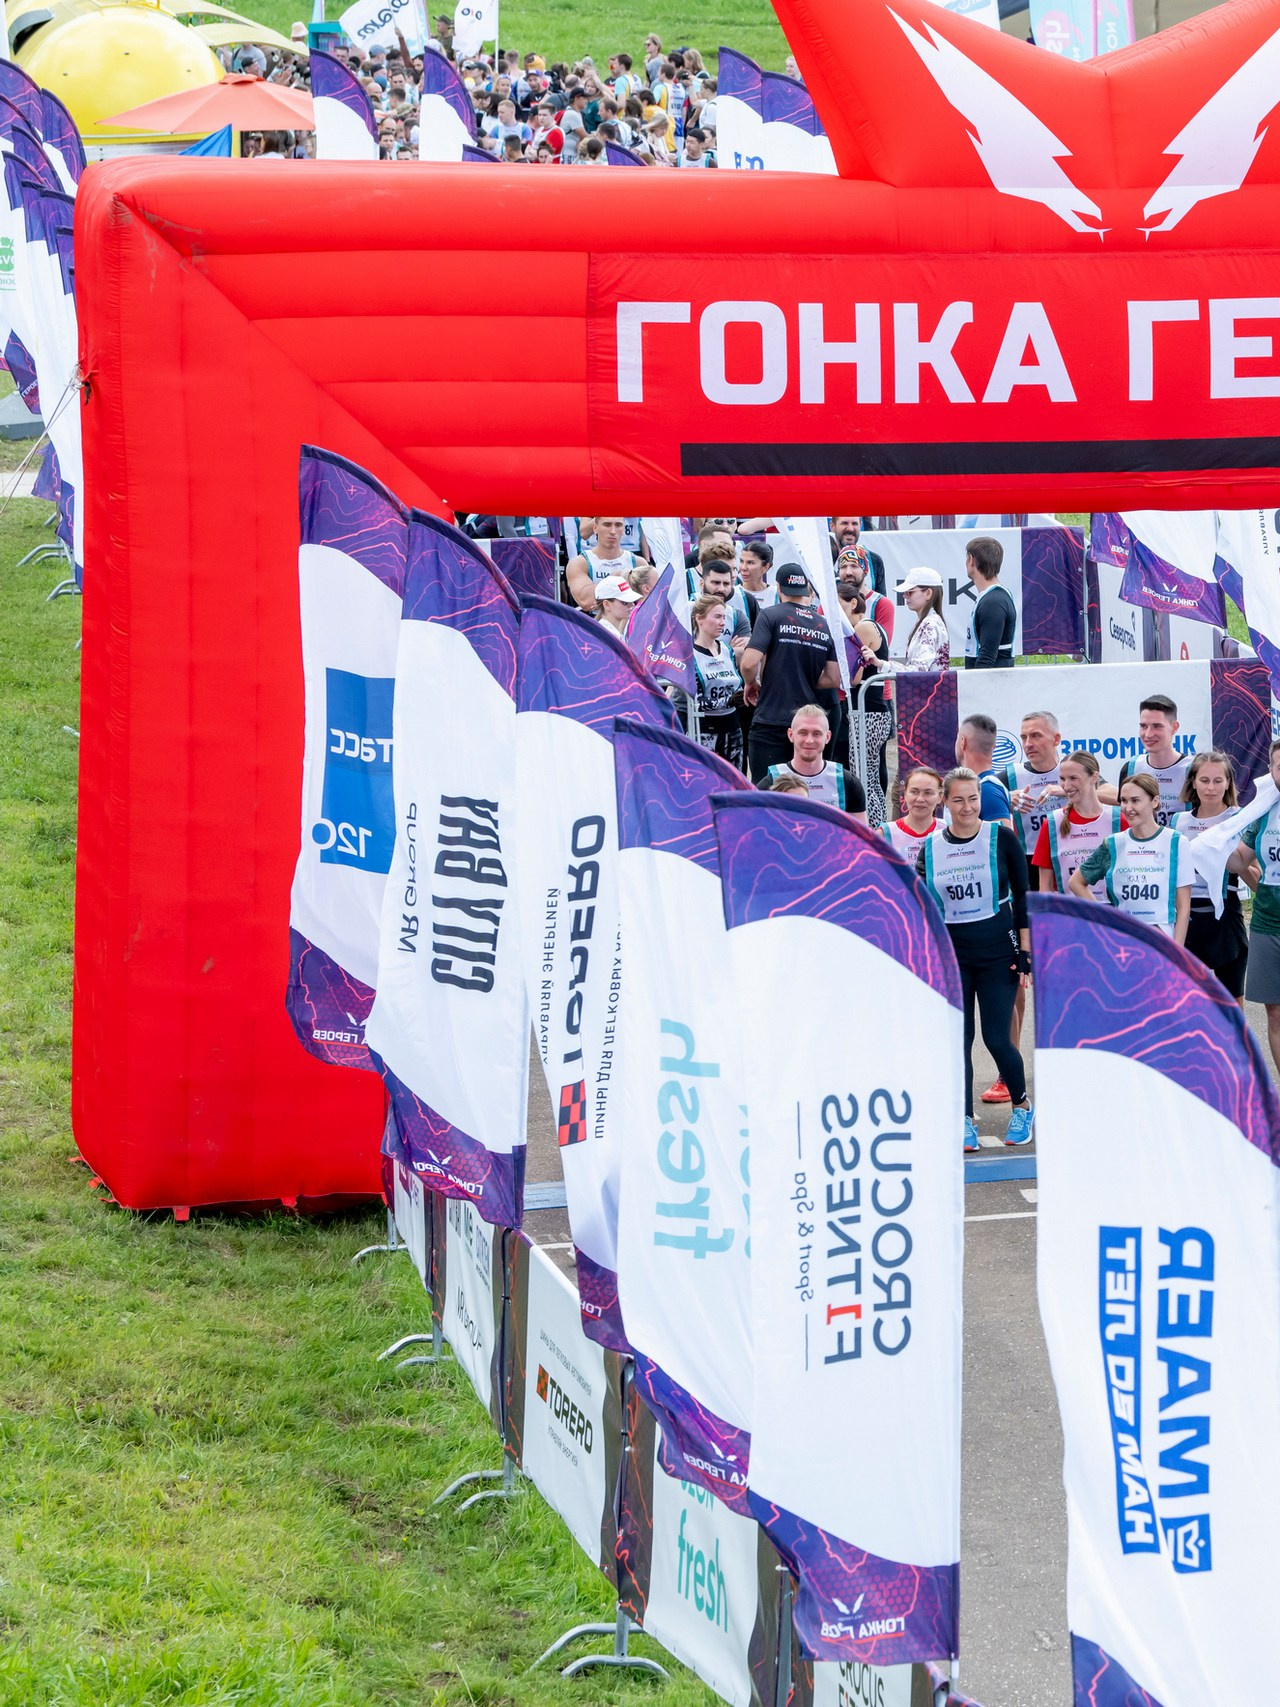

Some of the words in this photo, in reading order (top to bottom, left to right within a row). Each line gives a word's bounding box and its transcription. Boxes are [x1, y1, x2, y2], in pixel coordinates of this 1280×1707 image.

[617, 300, 1078, 405] ГОНКА
[21, 378, 39, 398] ГЕРО
[780, 624, 830, 641] ИНСТРУКТОР
[1109, 616, 1136, 651] Северсталь
[946, 881, 982, 901] 5041
[1122, 884, 1160, 900] 5040
[549, 1376, 593, 1455] TORERO
[677, 1508, 728, 1634] fresh
